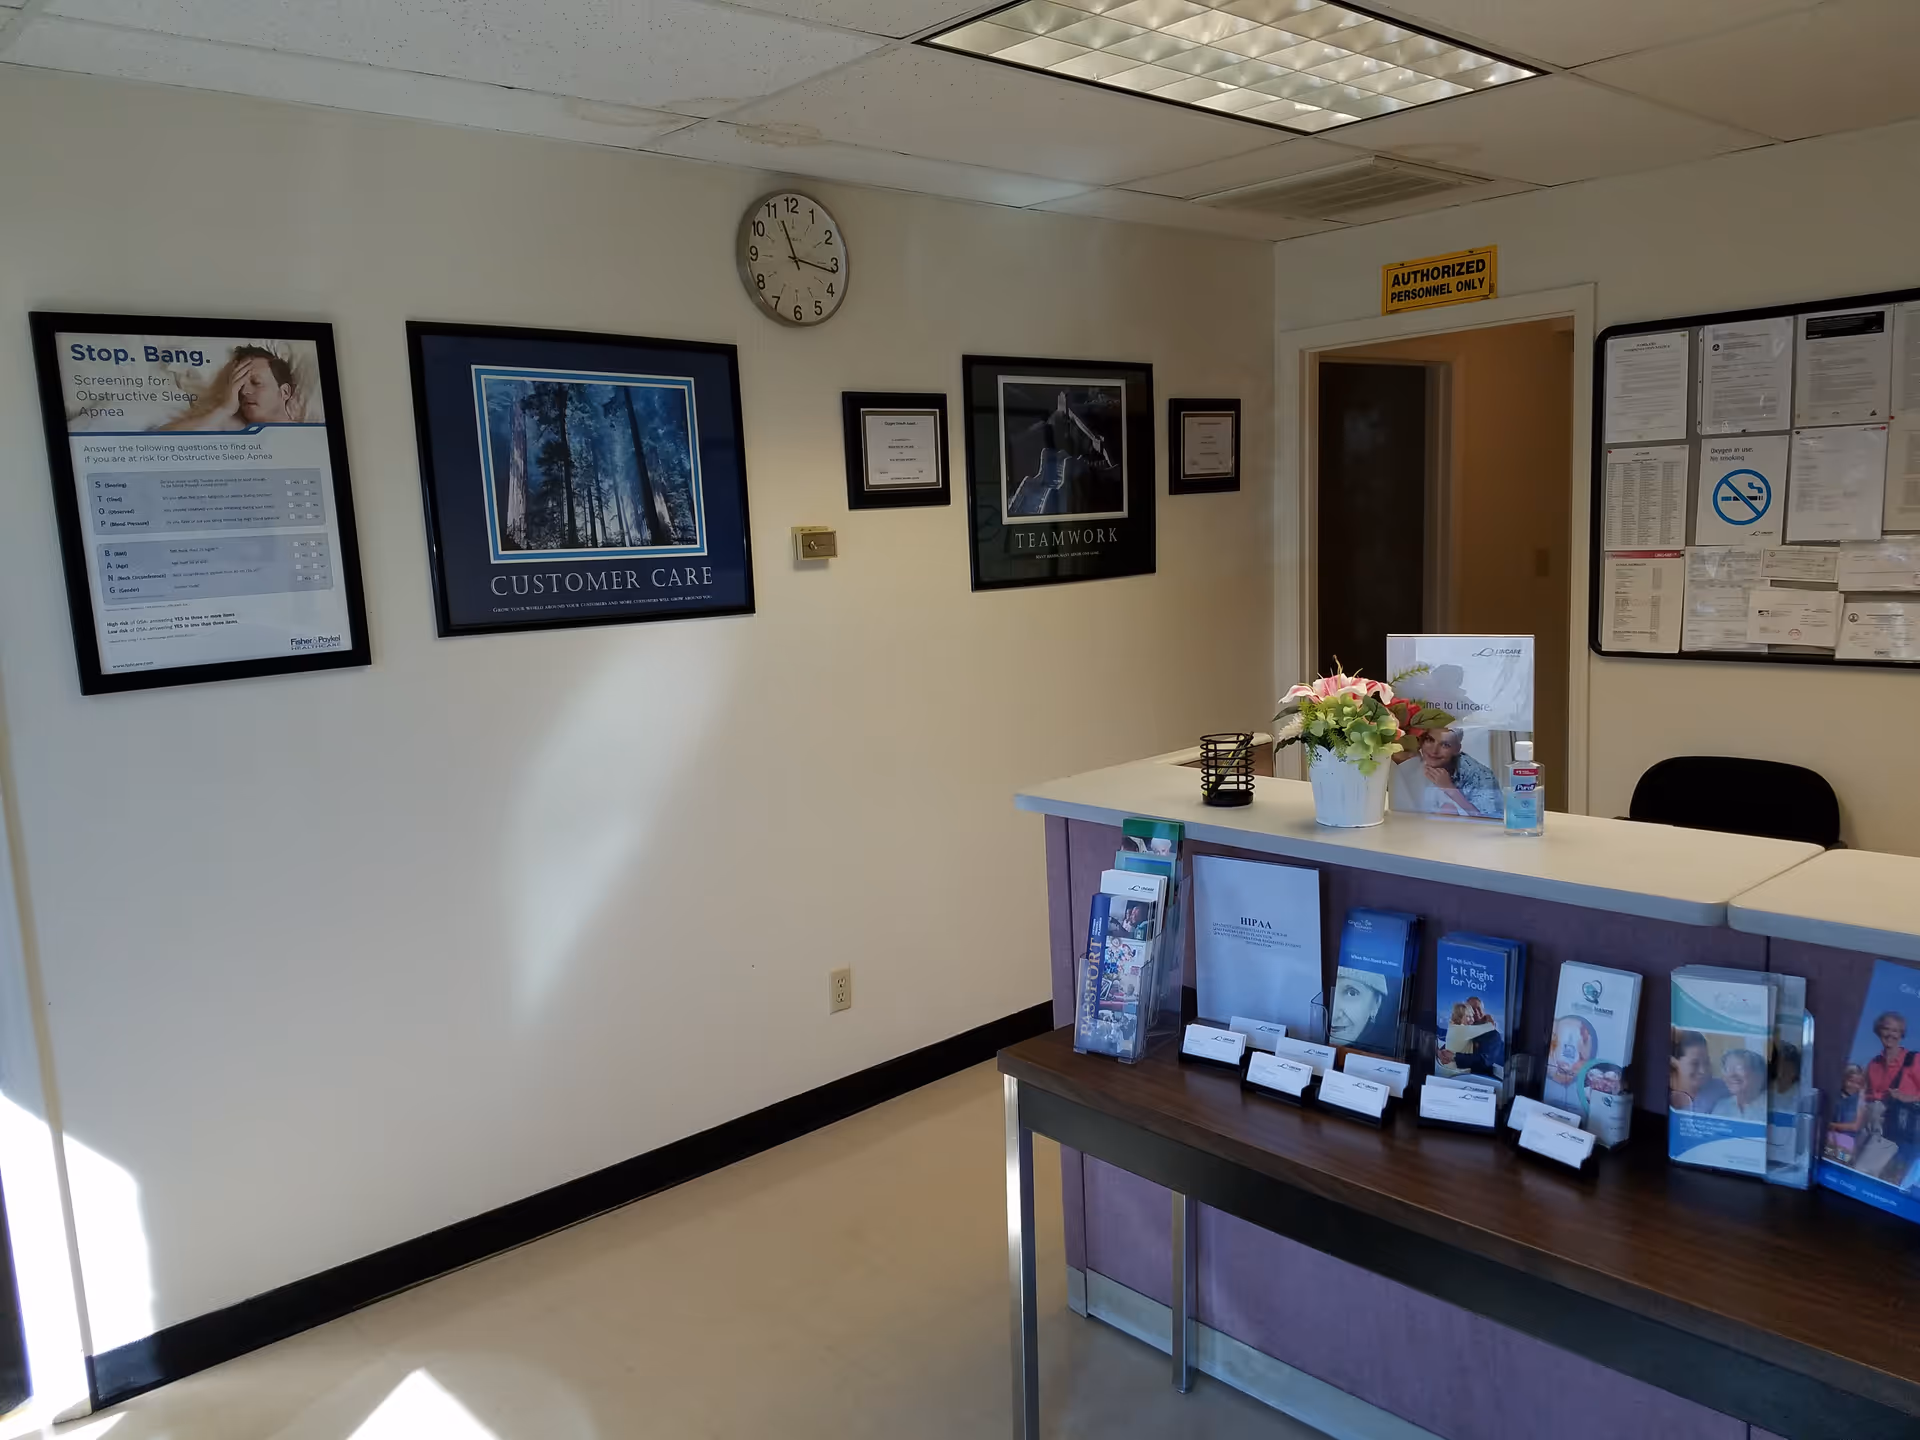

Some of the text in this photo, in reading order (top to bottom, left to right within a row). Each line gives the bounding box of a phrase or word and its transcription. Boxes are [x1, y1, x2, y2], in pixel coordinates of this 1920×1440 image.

[765, 202, 777, 219] 11
[784, 197, 799, 214] 12
[809, 209, 815, 224] 1
[752, 220, 765, 237] 10
[824, 230, 833, 245] 2
[749, 245, 758, 261] 9
[830, 257, 839, 274] 3
[1391, 258, 1486, 288] AUTHORIZED
[757, 273, 765, 290] 8
[826, 282, 835, 297] 4
[1390, 277, 1485, 303] PERSONNEL ONLY
[772, 295, 780, 310] 7
[814, 300, 823, 316] 5
[793, 305, 802, 321] 6
[70, 343, 211, 366] Stop. Bang.
[74, 374, 170, 388] Screening for:
[76, 391, 198, 403] Obstructive Sleep
[78, 406, 124, 418] Apnea
[83, 445, 116, 453] Answer
[136, 444, 175, 453] following
[177, 444, 218, 452] questions
[230, 443, 247, 451] find
[93, 457, 109, 465] you
[157, 454, 170, 462] for
[171, 453, 220, 462] Obstructive
[222, 453, 245, 462] Sleep
[247, 453, 273, 461] Apnea
[94, 481, 101, 489] S
[97, 495, 102, 503] T
[98, 507, 105, 515] O
[1015, 527, 1118, 549] TEAMWORK
[104, 549, 111, 557] B
[107, 574, 114, 582] N
[490, 567, 713, 596] CUSTOMER CARE
[109, 586, 116, 594] G
[1444, 701, 1453, 710] to
[1240, 916, 1273, 930] HIPAA
[1450, 964, 1494, 982] Is It Right
[1450, 975, 1487, 992] for You?
